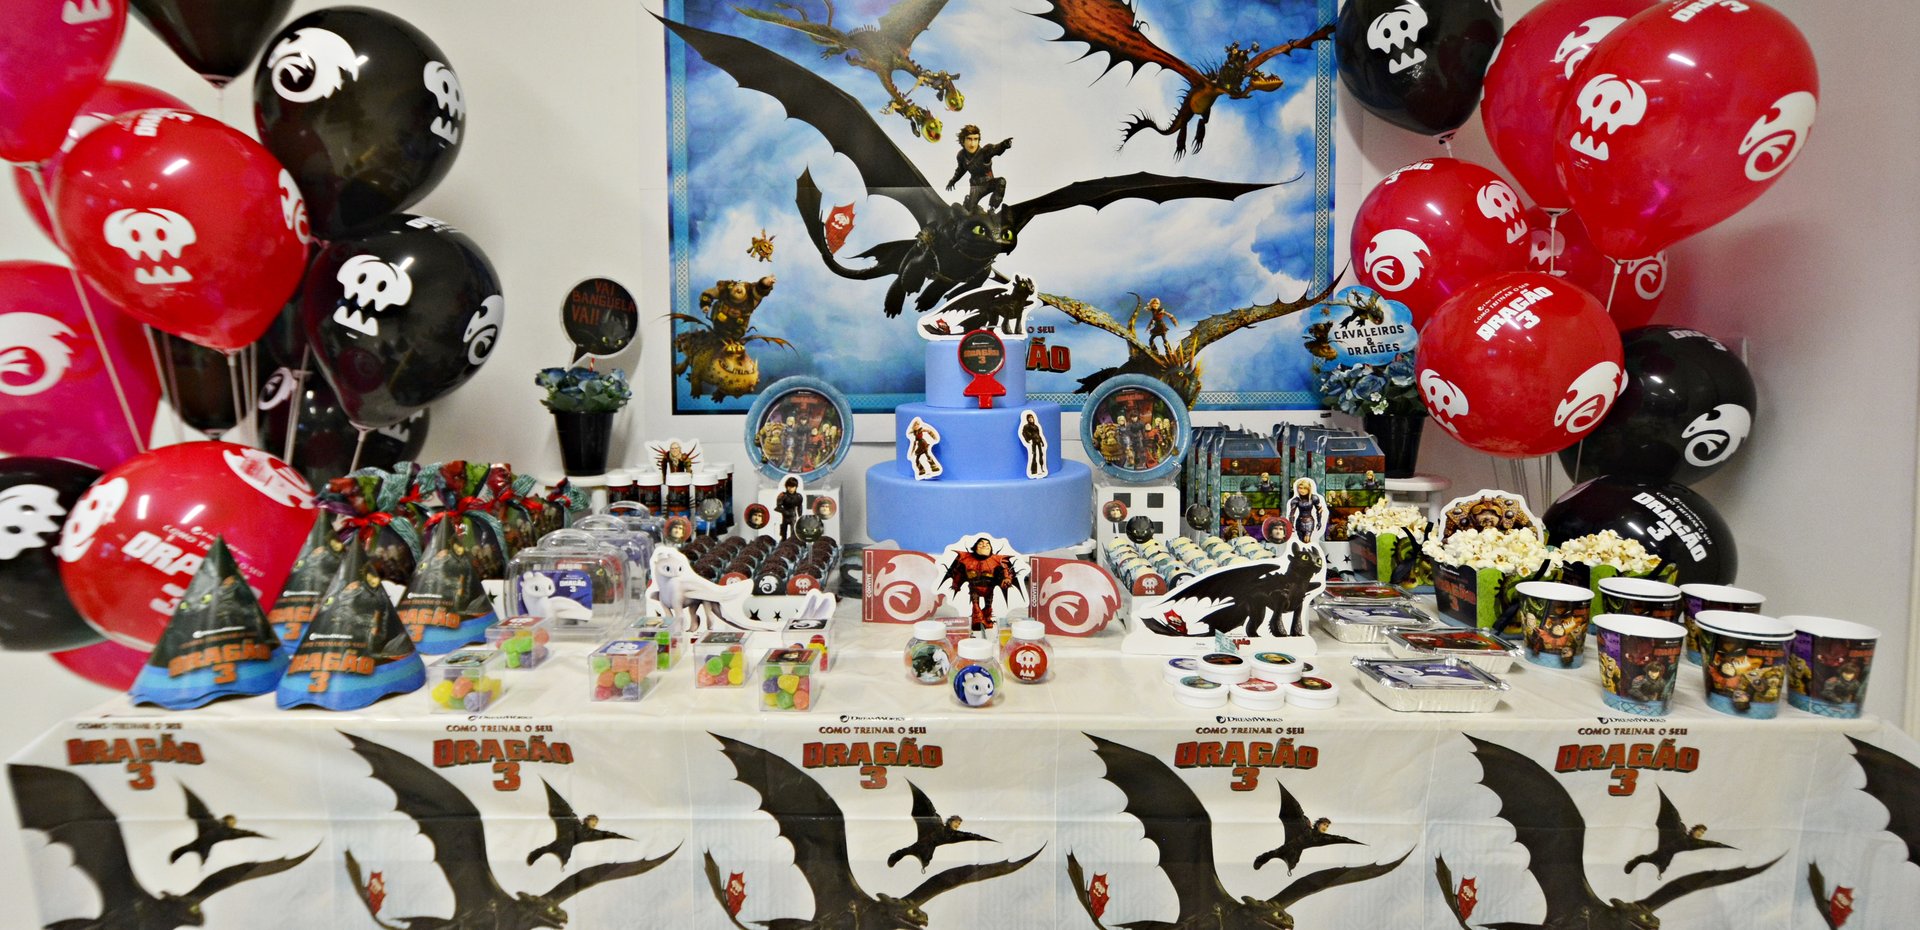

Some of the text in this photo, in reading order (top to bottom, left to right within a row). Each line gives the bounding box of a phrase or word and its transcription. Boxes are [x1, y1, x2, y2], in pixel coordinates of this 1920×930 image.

[1476, 286, 1554, 341] DRAGÃO
[1515, 309, 1541, 330] 3
[1037, 325, 1055, 334] SEU
[1334, 324, 1405, 340] CAVALEIROS
[1366, 337, 1375, 346] &
[978, 356, 987, 364] 3
[1347, 342, 1400, 355] DRAGÕES
[1632, 492, 1707, 562] DRAGÃO
[1646, 520, 1673, 541] 3
[212, 662, 237, 684] 3
[308, 671, 331, 693] 3
[66, 733, 205, 765] DRAGÃO
[433, 735, 574, 768] DRAGÃO
[803, 737, 943, 769] DRAGÃO
[1174, 737, 1319, 770] DRAGÃO
[1554, 738, 1700, 773] DRAGÃO
[126, 761, 155, 791] 3
[492, 761, 521, 791] 3
[860, 765, 888, 789] 3
[1230, 766, 1260, 791] 3
[1608, 767, 1639, 796] 3
